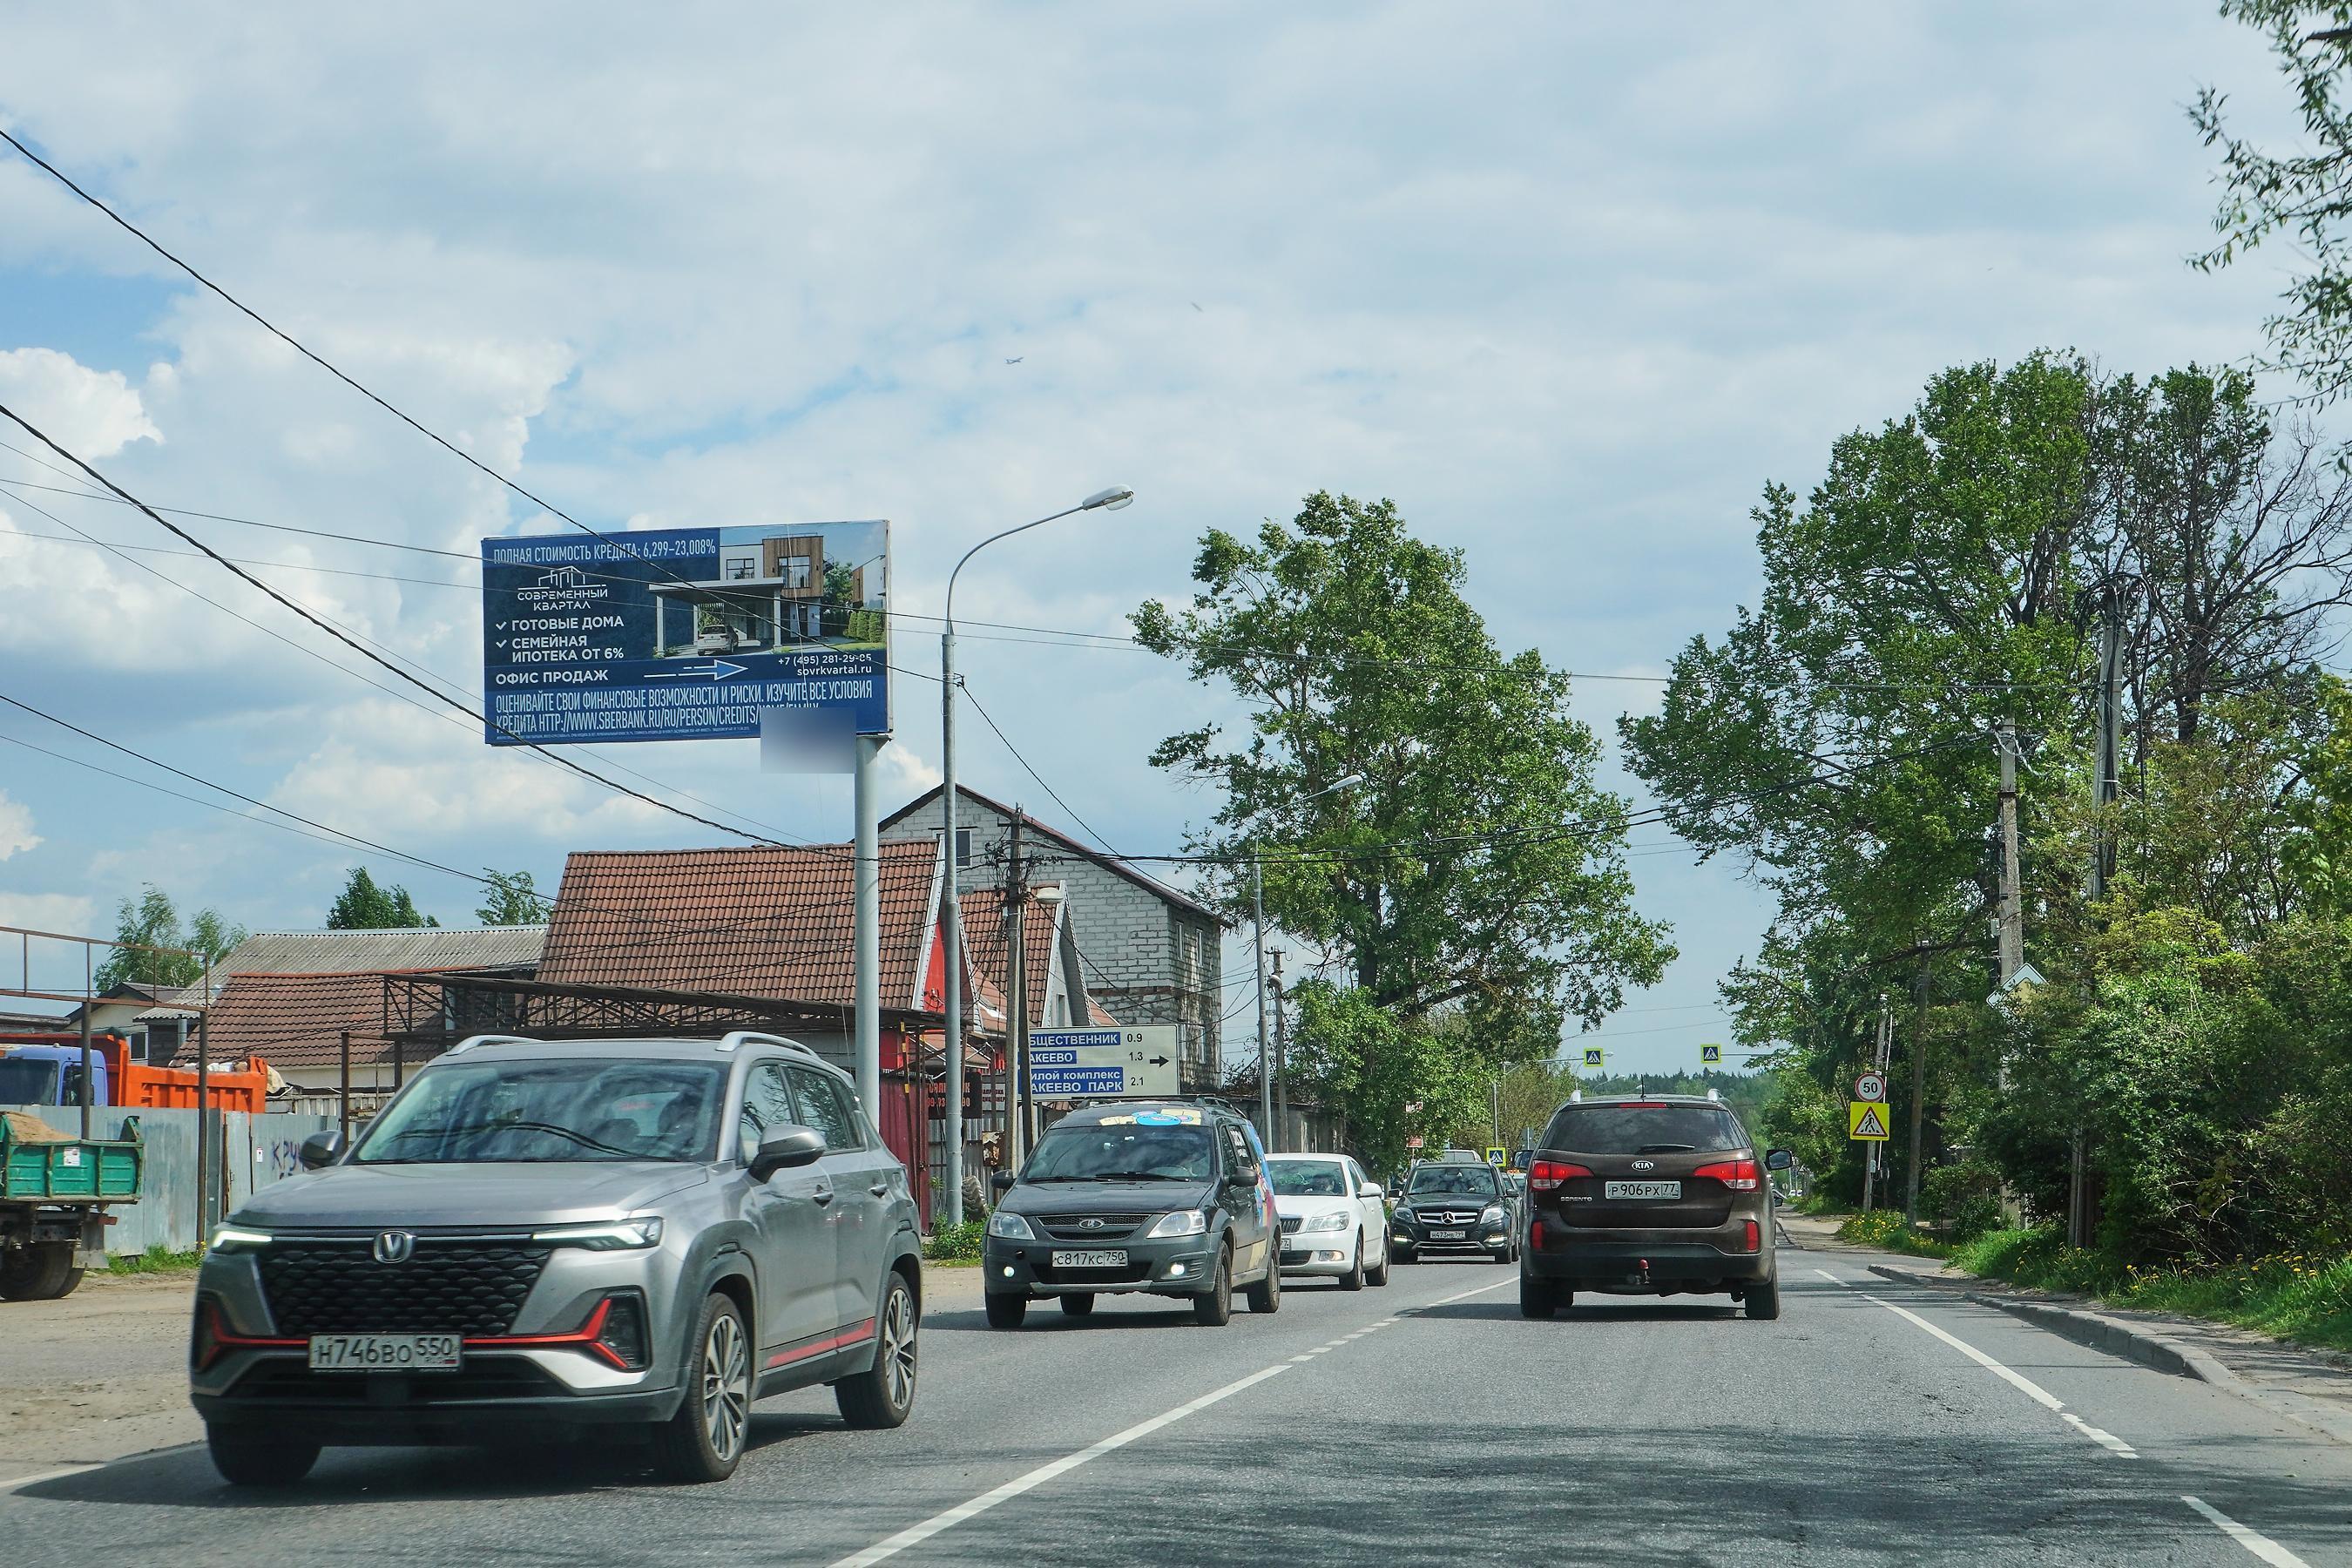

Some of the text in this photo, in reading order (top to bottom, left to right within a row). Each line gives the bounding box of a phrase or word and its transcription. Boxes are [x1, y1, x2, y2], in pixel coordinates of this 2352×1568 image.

[494, 547, 532, 564] ПОЛНАЯ
[534, 544, 591, 563] СТОИМОСТЬ
[594, 543, 641, 562] КРЕДИТА:
[533, 600, 591, 612] КВАРТАЛ
[511, 615, 625, 632] ГОТОВЫЕ ДОМА
[511, 633, 588, 649] СЕМЕЙНАЯ
[512, 647, 625, 663] ИПОТЕКА ОТ 6%
[778, 657, 791, 666] +7
[794, 655, 820, 666] (495)
[797, 664, 872, 676] sovrkvartal.ru
[496, 669, 609, 686] ОФИС ПРОДАЖ
[496, 679, 873, 713] ОЦЕНИВАЙТЕ СВОИ ФИНАНСОВЫЕ ВОЗМОЖНОСТИ И РИСКИ. ИЗУЧИТЕ ВСЕ УСЛОВИЯ
[497, 714, 537, 735] КРЕДИТА
[1030, 1033, 1143, 1047] БЩЕСТВЕННИК 0.9
[1030, 1051, 1144, 1064] АКЕЕВО 1.3
[1031, 1071, 1121, 1081] илой комплекс
[1131, 1076, 1145, 1087] 2.1
[1031, 1081, 1124, 1093] АКЕЕВО ПАРК
[1862, 1082, 1878, 1093] 50
[1611, 1183, 1675, 1196] Р906РХ 77
[1057, 1252, 1124, 1265] С817КС 750
[317, 1337, 453, 1364] Н746ВО 550
